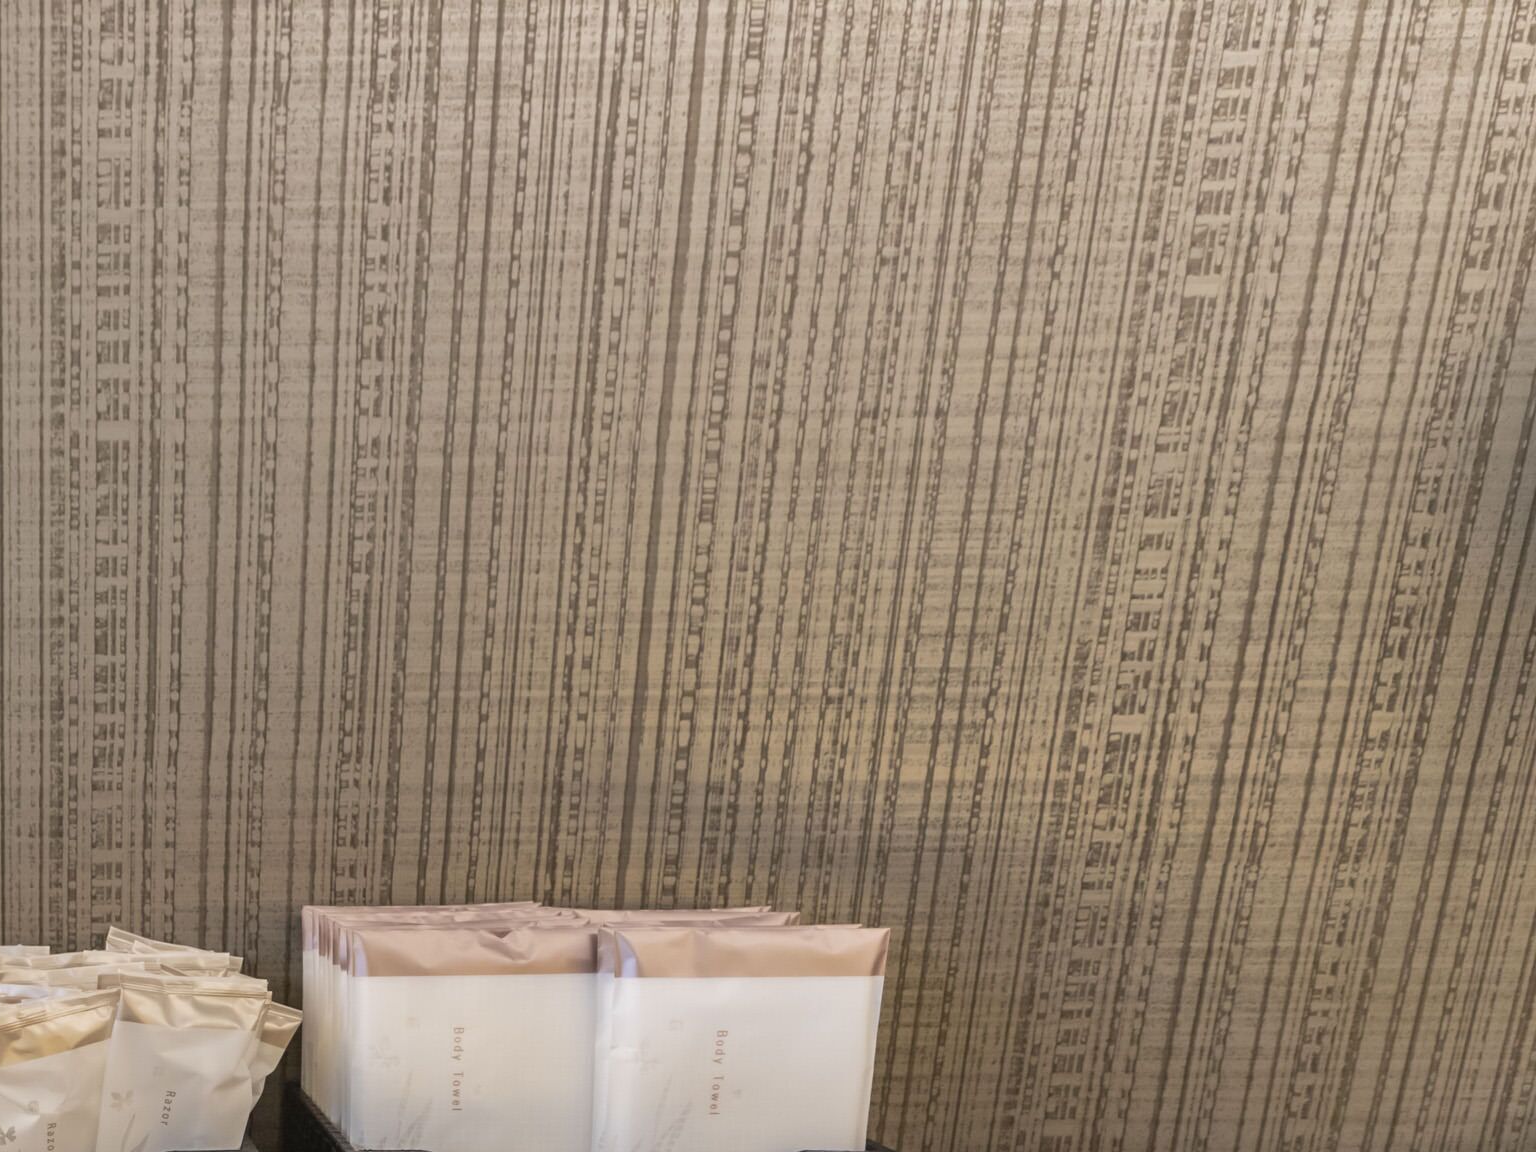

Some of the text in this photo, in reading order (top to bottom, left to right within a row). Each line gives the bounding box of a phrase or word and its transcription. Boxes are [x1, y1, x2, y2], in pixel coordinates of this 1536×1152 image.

[160, 1090, 177, 1127] Razor
[450, 1026, 465, 1112] Body Towel
[708, 1029, 729, 1116] Body Towel
